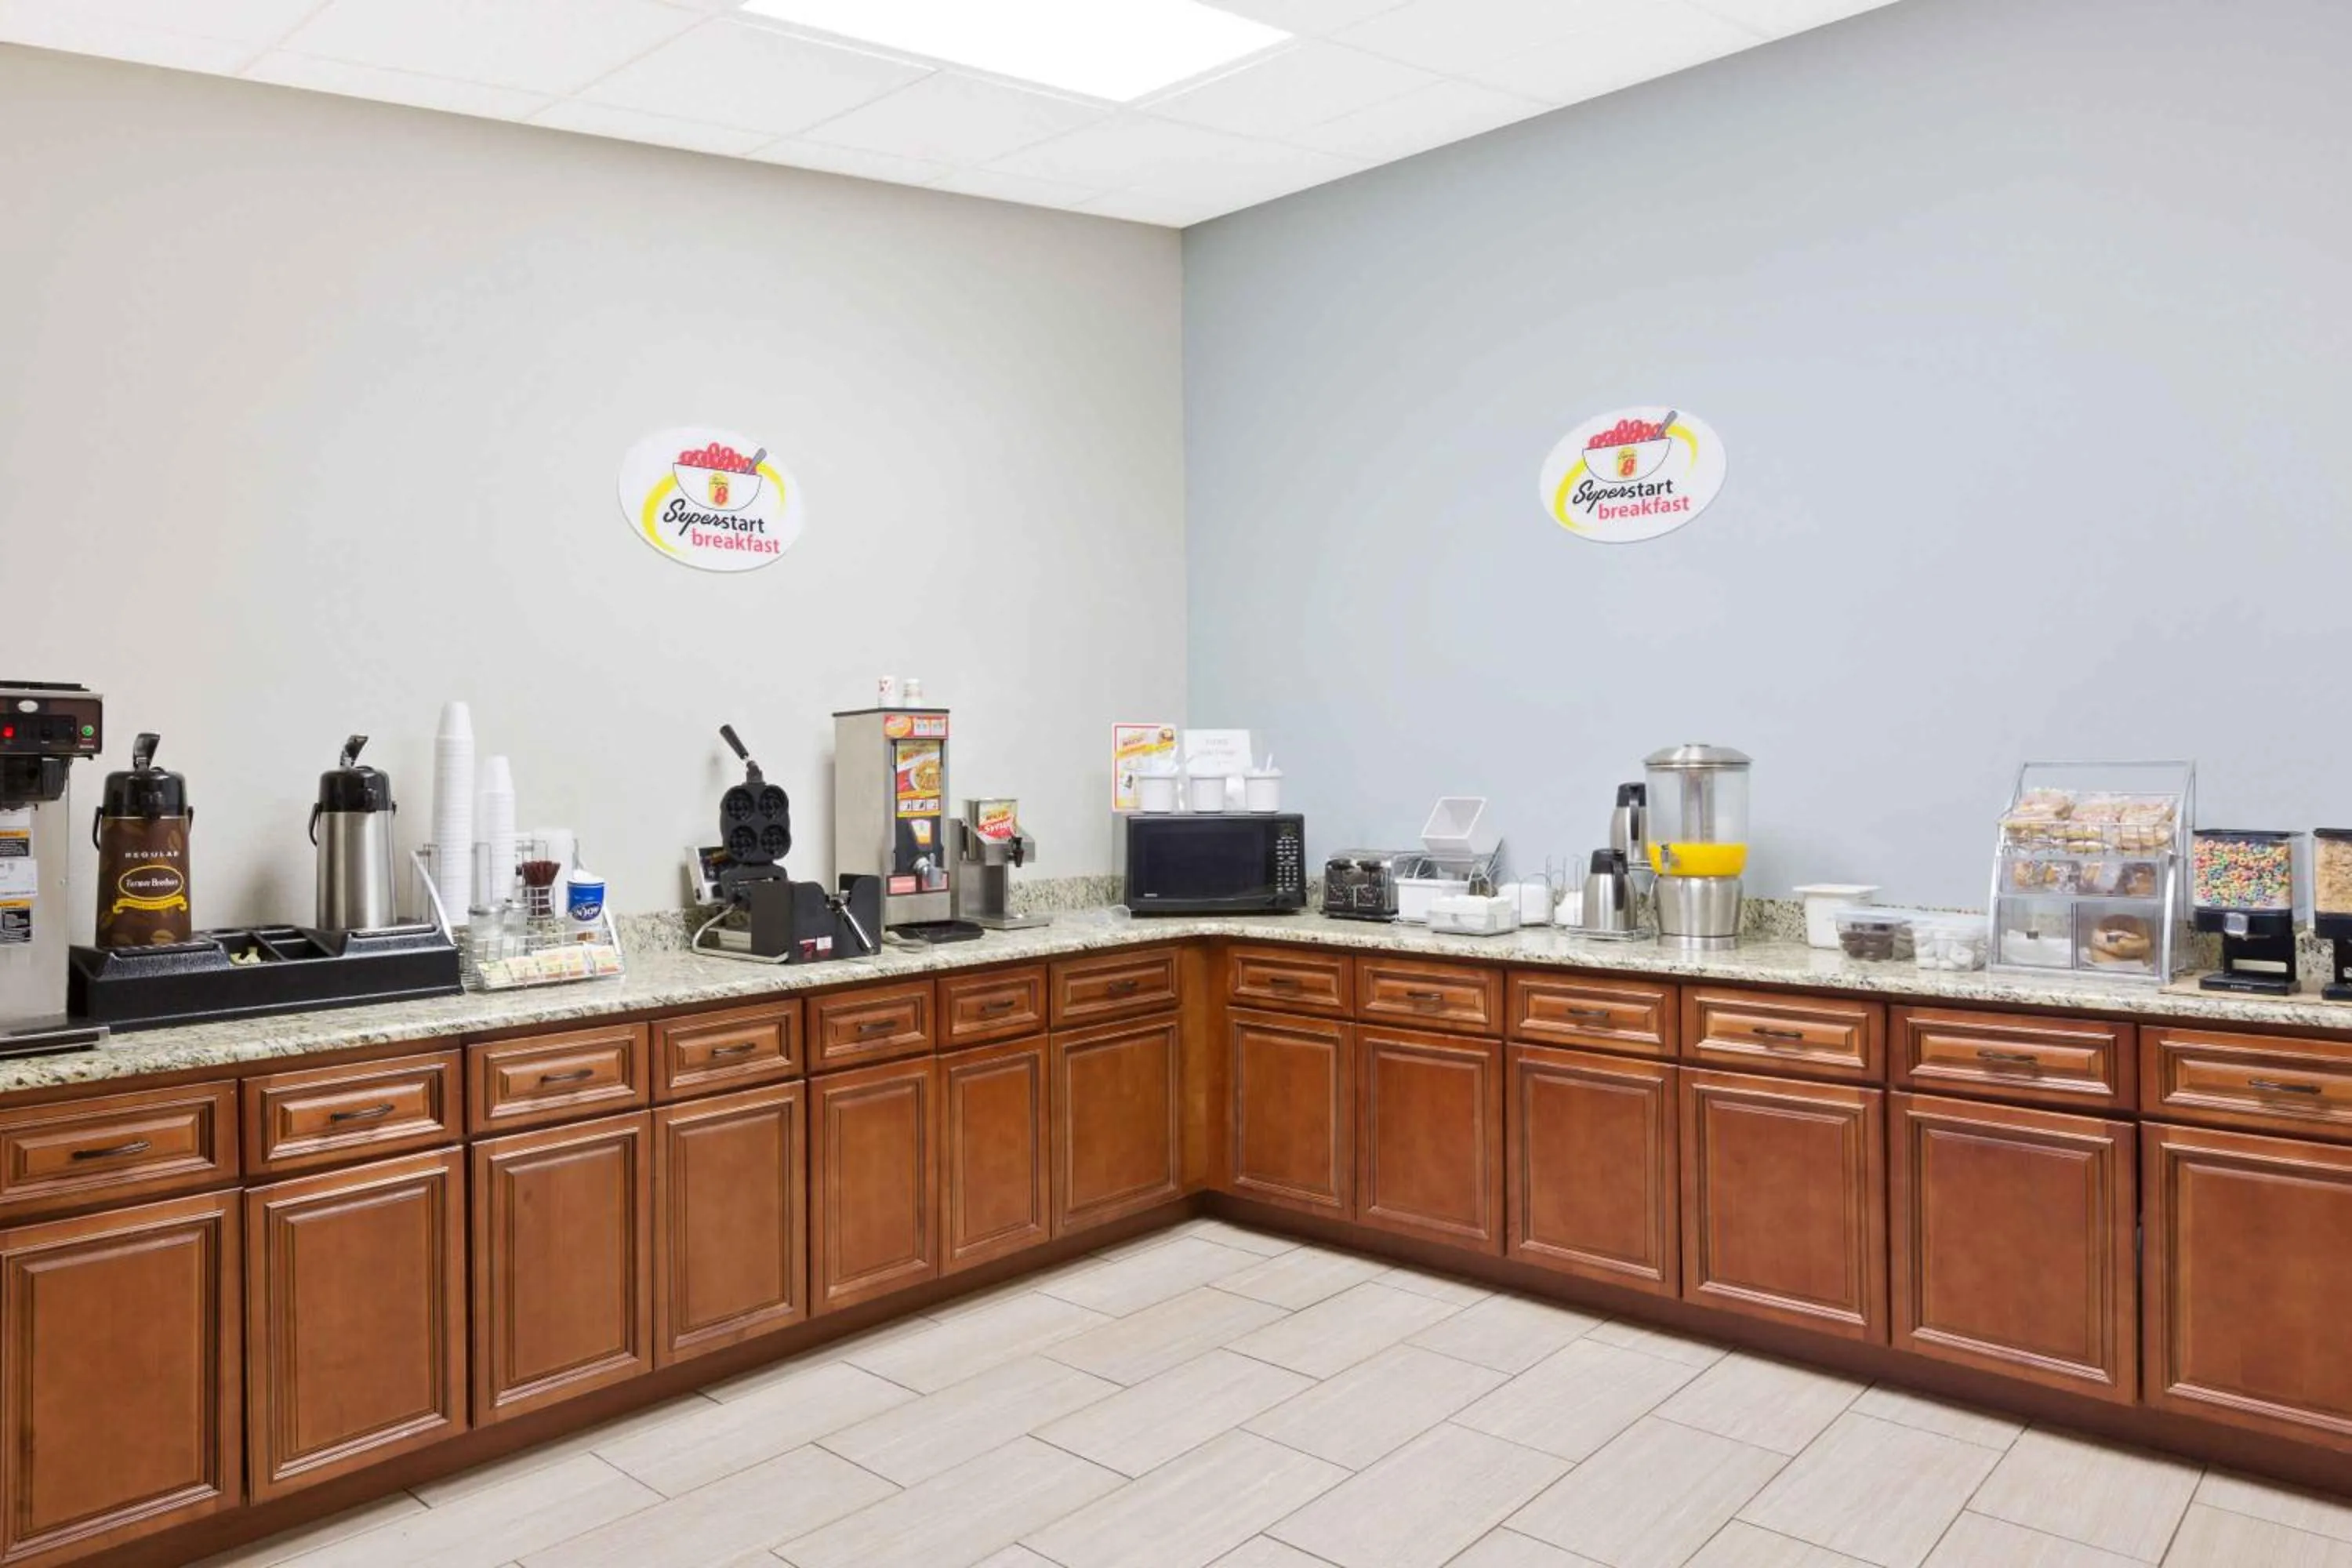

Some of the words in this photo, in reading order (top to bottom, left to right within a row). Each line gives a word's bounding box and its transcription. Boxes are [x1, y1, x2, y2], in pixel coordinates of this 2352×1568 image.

[1572, 479, 1673, 514] Superstart
[1598, 496, 1690, 520] breakfast
[663, 498, 764, 536] Superstart
[691, 528, 780, 554] breakfast
